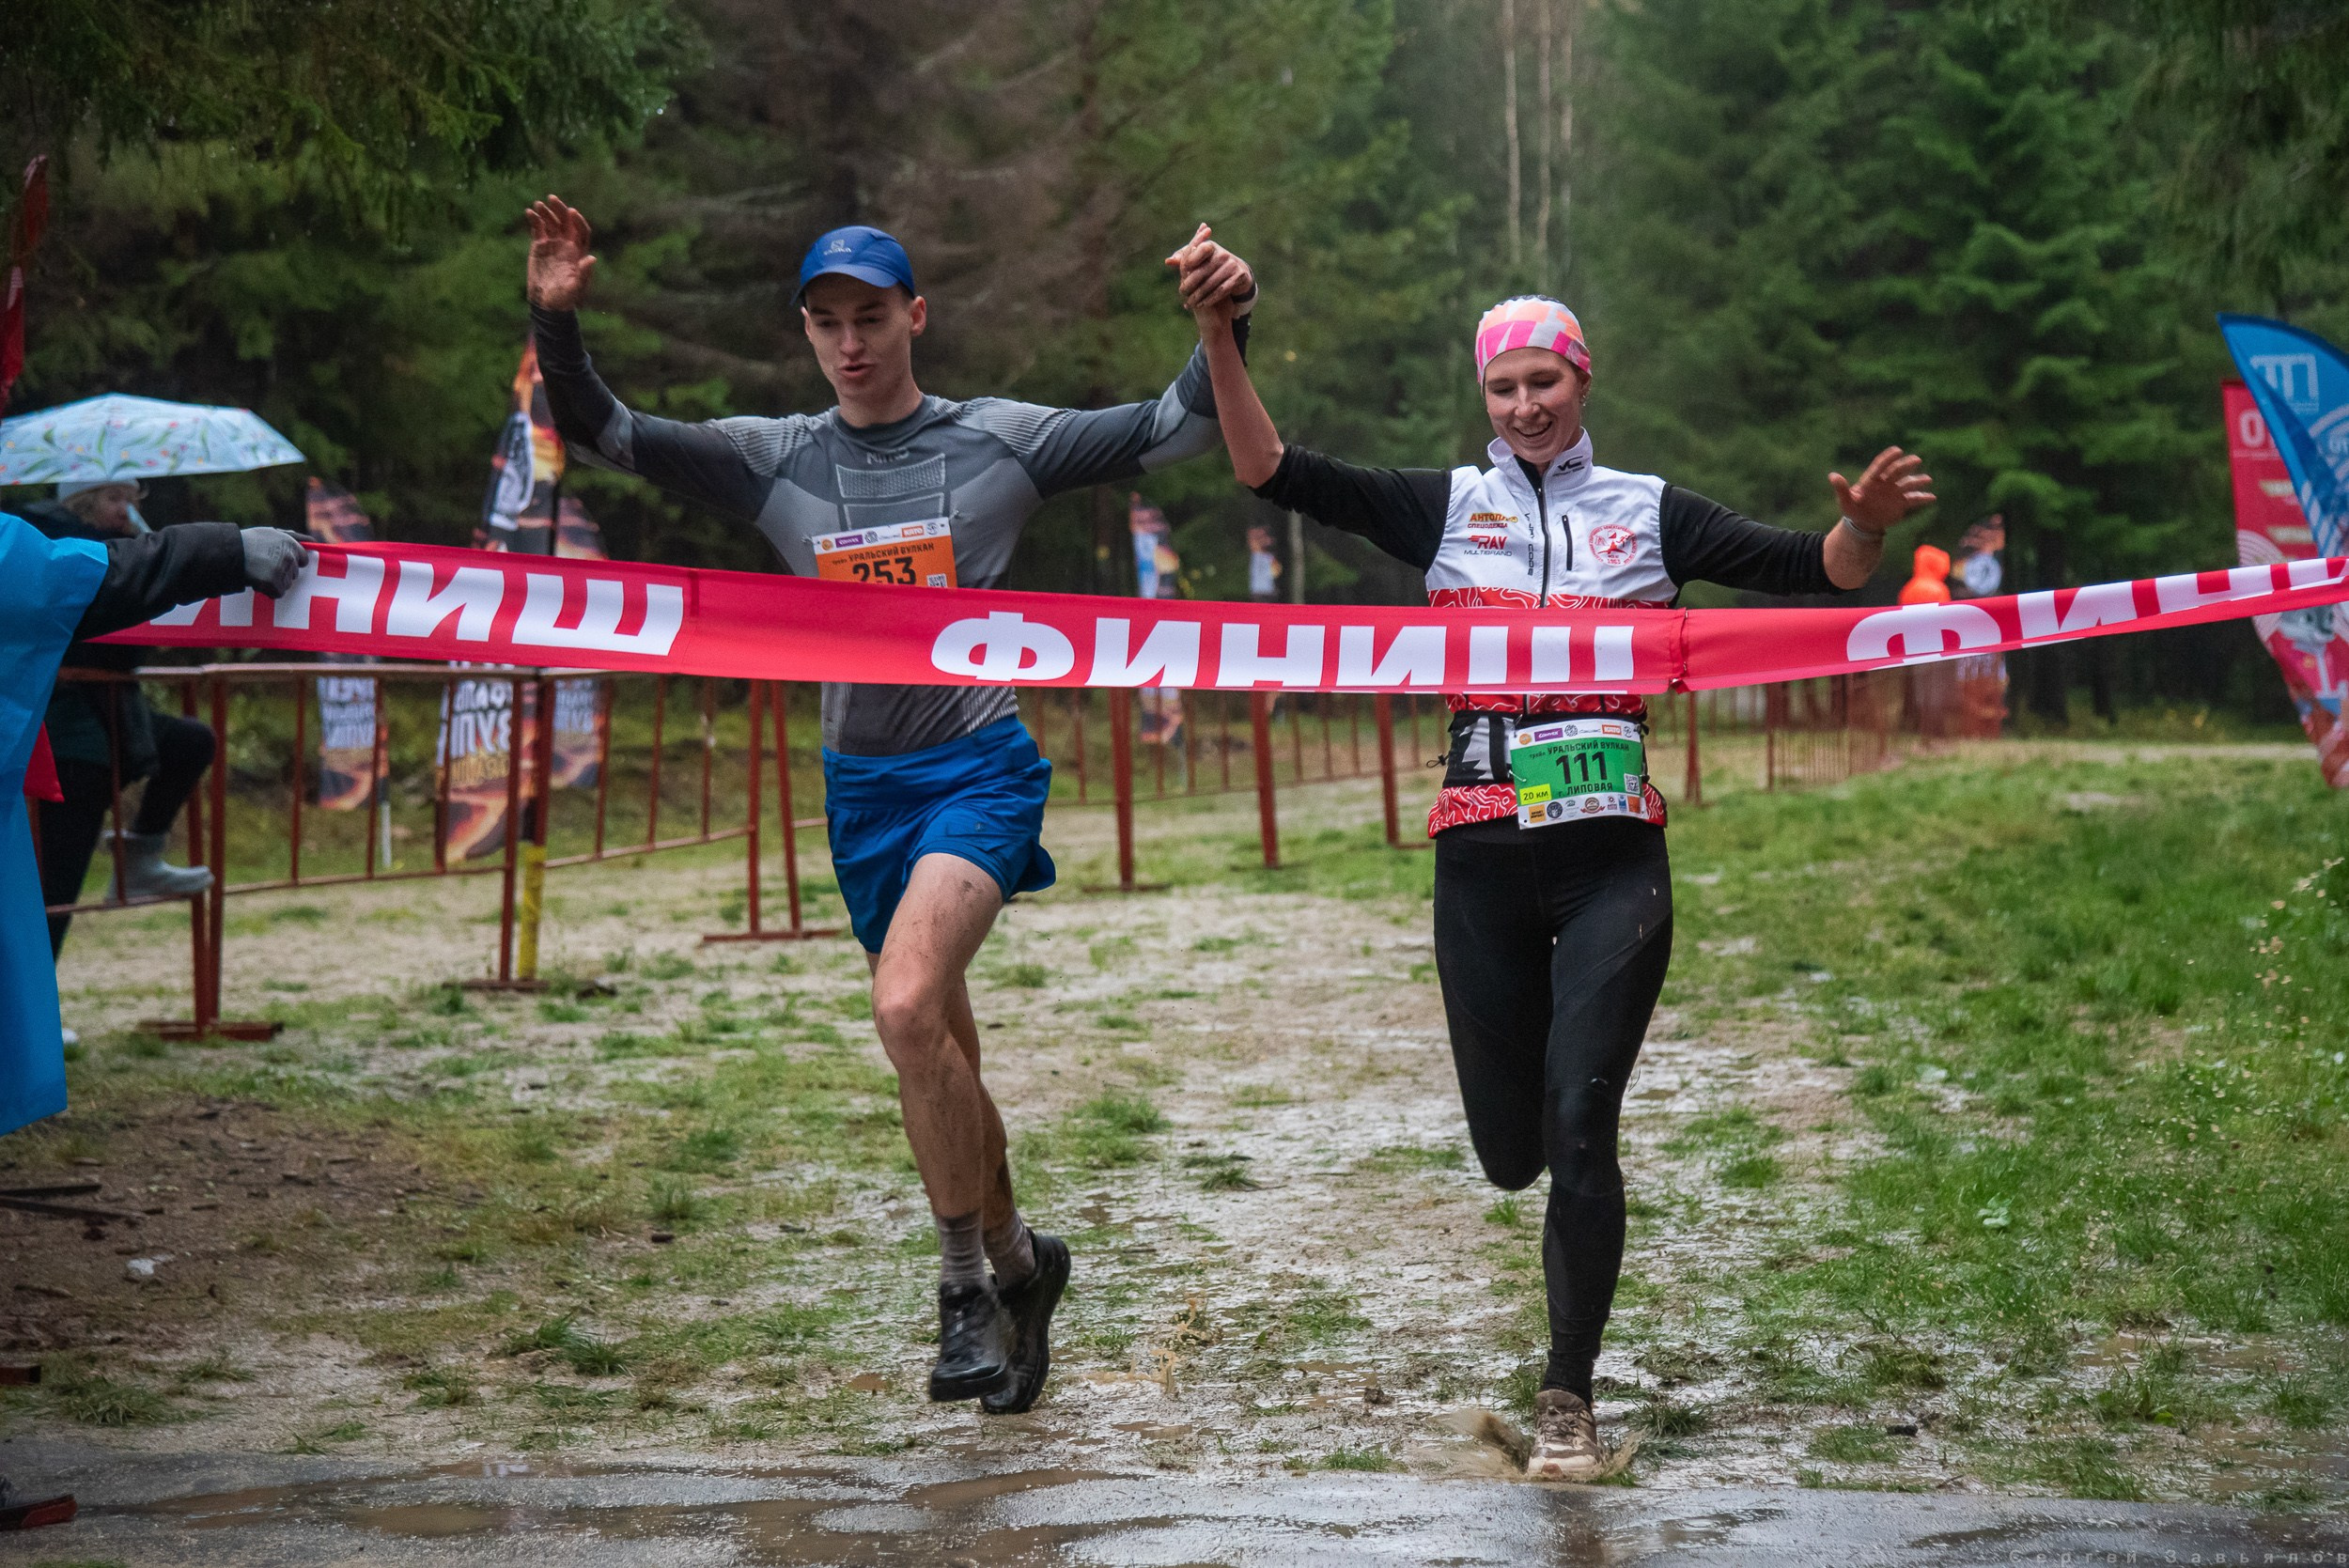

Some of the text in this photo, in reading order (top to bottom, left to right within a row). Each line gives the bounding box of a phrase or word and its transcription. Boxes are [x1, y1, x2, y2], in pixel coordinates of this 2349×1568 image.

[848, 546, 899, 563] УРАЛЬСКИЙ
[901, 542, 935, 556] ВУЛКАН
[852, 556, 917, 586] 253
[930, 611, 1635, 693] ФИНИШ
[1548, 739, 1598, 754] УРАЛЬСКИЙ
[1600, 741, 1629, 752] ВУЛКАН
[1556, 751, 1608, 784] 111
[1523, 791, 1534, 800] 20
[1567, 782, 1613, 796] ЛИПОВАЯ
